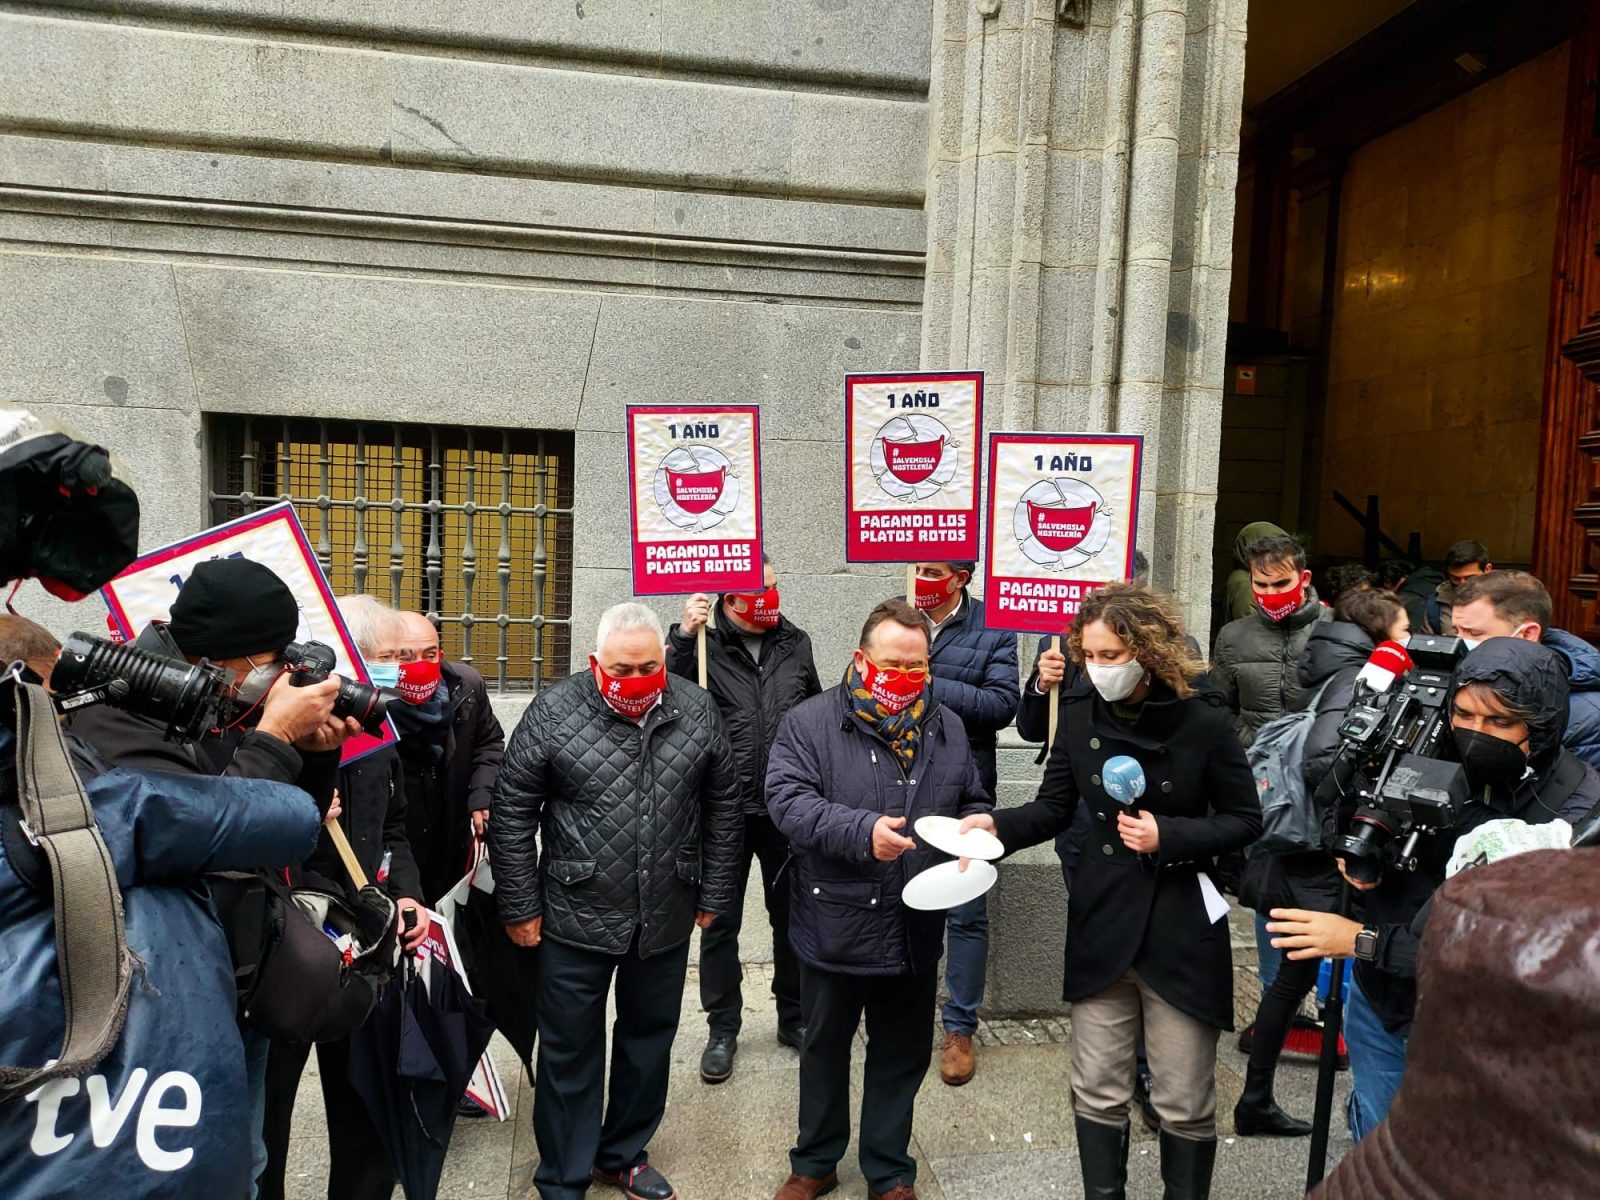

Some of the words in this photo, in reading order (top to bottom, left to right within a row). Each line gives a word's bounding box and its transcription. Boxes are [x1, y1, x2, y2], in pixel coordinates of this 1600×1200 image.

[887, 394, 895, 408] 1
[902, 390, 940, 408] AÑO
[668, 424, 677, 438] 1
[683, 421, 720, 438] AÑO
[892, 456, 936, 464] SALVEMOSLA
[892, 463, 933, 471] HOSTELERÍA
[1034, 455, 1043, 470] 1
[1050, 452, 1092, 471] AÑO
[860, 515, 934, 529] PAGANDO
[938, 514, 966, 527] LOS
[1037, 522, 1085, 531] SALVEMOSLA
[860, 529, 914, 543] PLATOS
[918, 529, 966, 542] ROTOS
[1037, 529, 1082, 538] HOSTELERÍA
[646, 545, 720, 559] PAGANDO
[723, 543, 751, 557] LOS
[646, 560, 700, 574] PLATOS
[704, 559, 752, 572] ROTOS
[1000, 581, 1081, 598] PAGANDO
[999, 597, 1058, 613] PLATOS
[1431, 719, 1444, 737] SONY
[25, 1059, 203, 1171] tve
